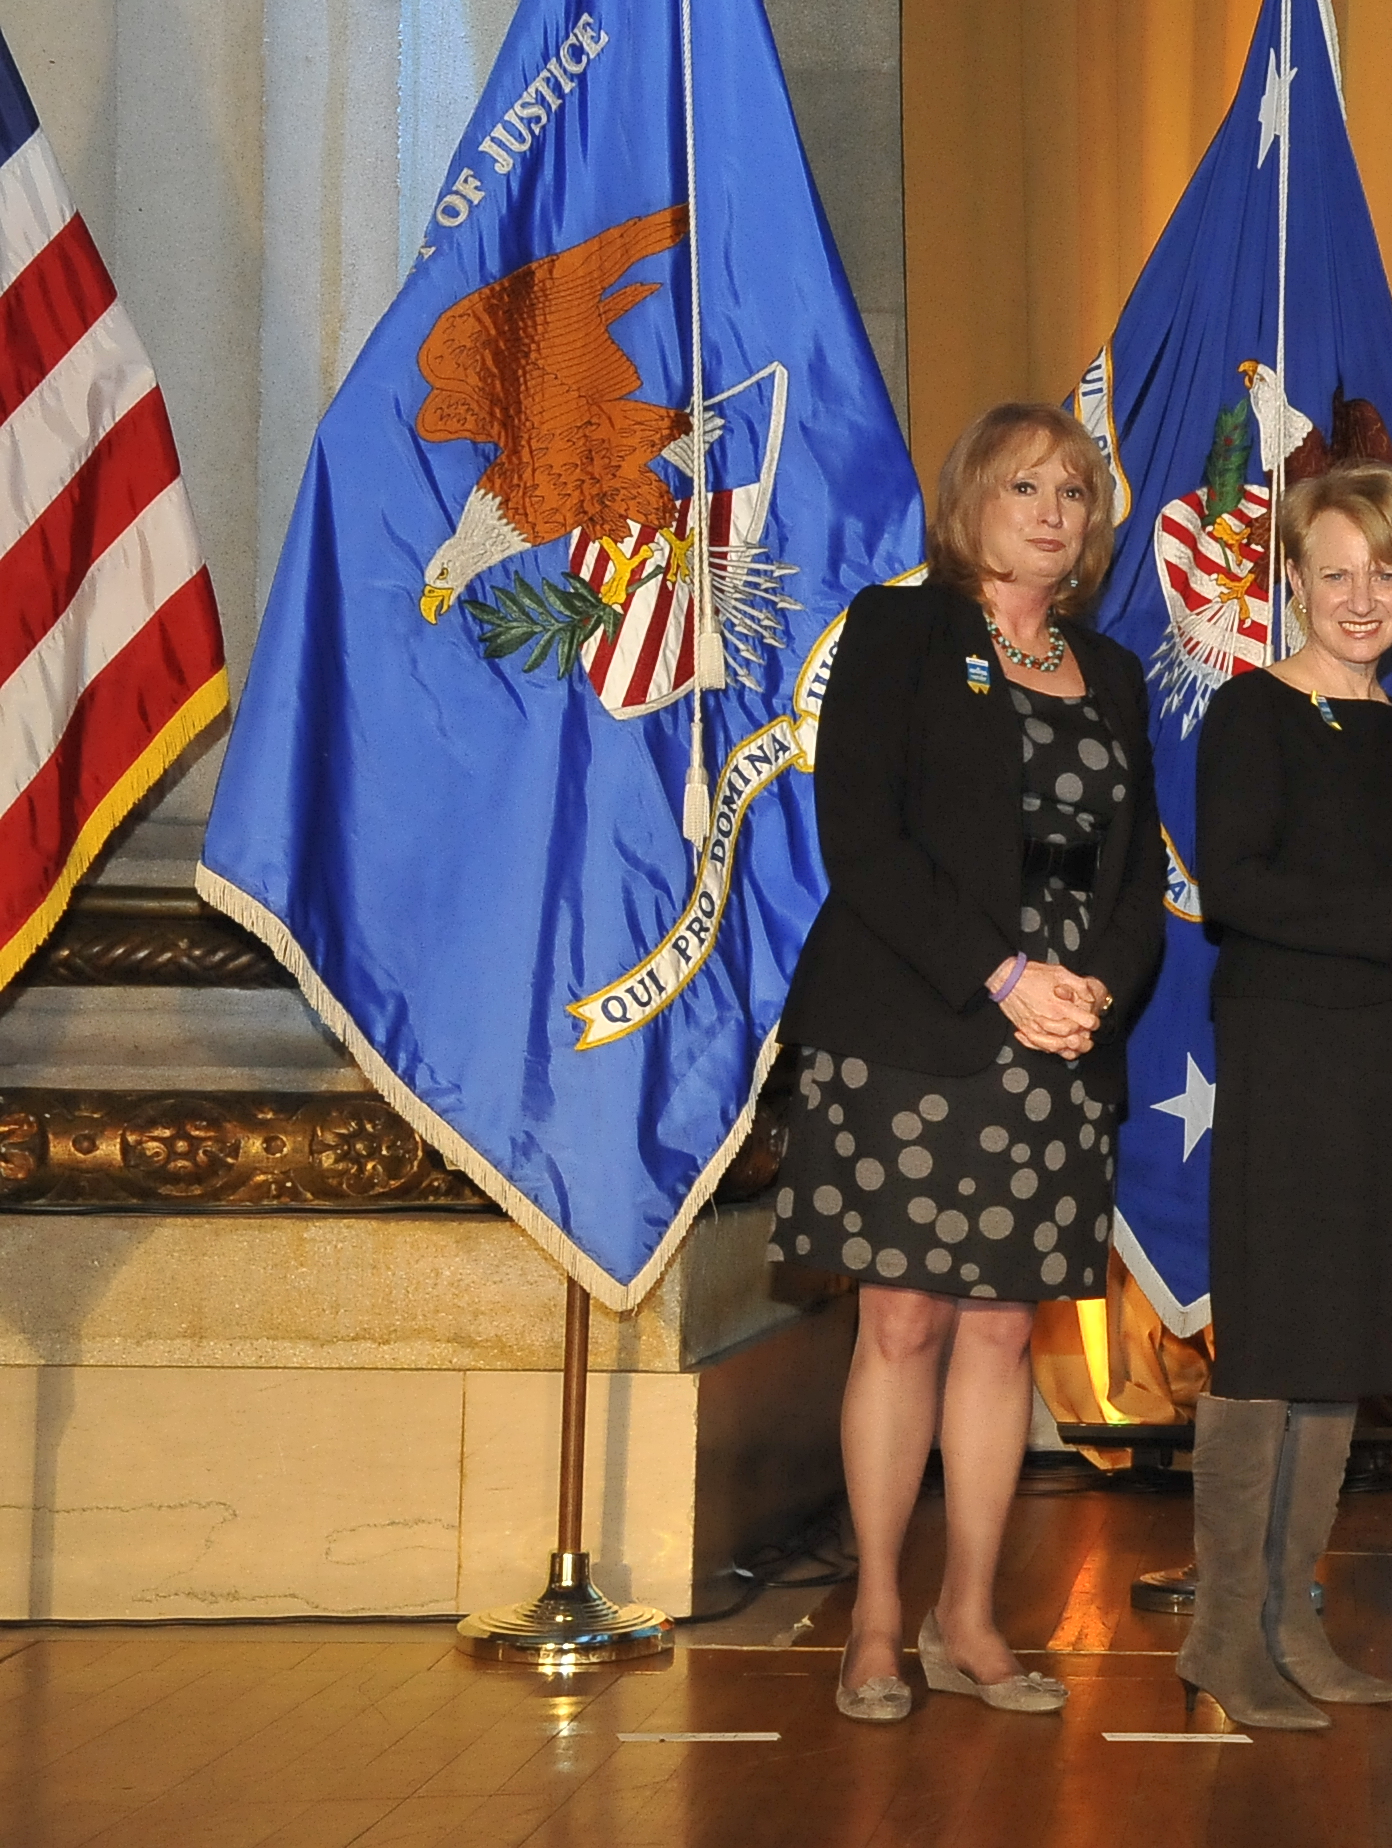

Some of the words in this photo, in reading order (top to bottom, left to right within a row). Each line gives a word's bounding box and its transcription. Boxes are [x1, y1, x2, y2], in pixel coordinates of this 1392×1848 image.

[435, 167, 486, 228] OF
[478, 12, 610, 174] JUSTICE
[1081, 352, 1105, 398] UI
[600, 967, 670, 1025] QUI
[672, 889, 717, 963] PRO
[710, 733, 792, 868] DOMINA
